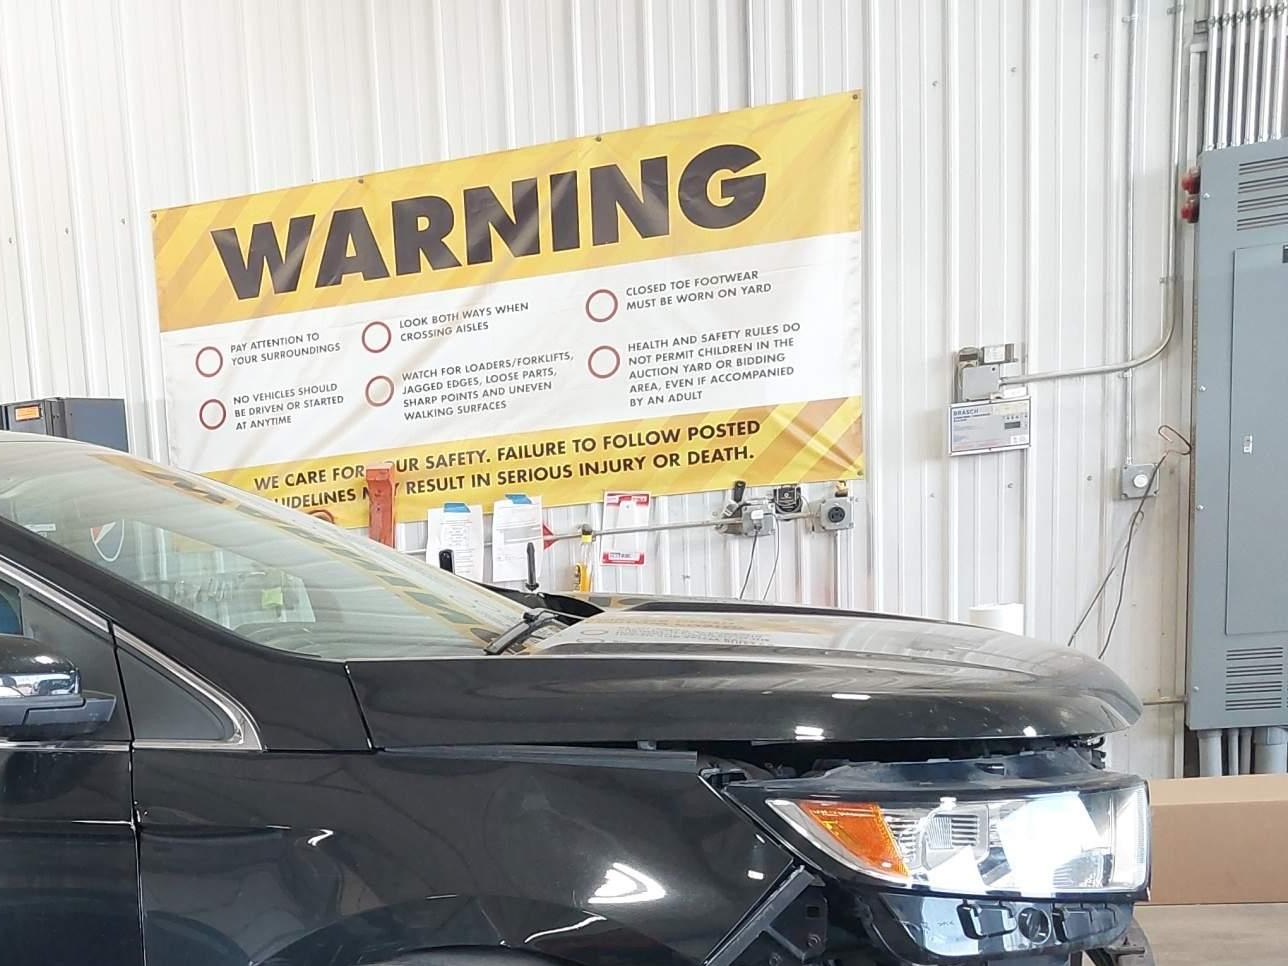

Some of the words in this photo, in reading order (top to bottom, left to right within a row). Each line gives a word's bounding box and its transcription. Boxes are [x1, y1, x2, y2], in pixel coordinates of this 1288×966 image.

[211, 143, 767, 300] WARNING
[626, 283, 666, 296] CLOSED
[670, 280, 691, 289] TOE
[694, 271, 758, 287] FOOTWEAR
[626, 299, 656, 310] MUST
[660, 297, 672, 306] BE
[676, 291, 713, 304] WORN
[718, 288, 737, 297] ON
[741, 283, 772, 295] YARD
[400, 317, 428, 328] LOOK
[432, 312, 459, 324] BOTH
[462, 307, 492, 319] WAYS
[495, 302, 529, 314] WHEN
[231, 343, 247, 352] PAY
[251, 335, 303, 350] ATTENTION
[306, 333, 319, 341] TO
[401, 327, 452, 342] CROSSING
[456, 322, 489, 333] AISLES
[628, 339, 668, 352] HEALTH
[672, 335, 697, 346] AND
[701, 330, 741, 343] SAFETY
[745, 325, 779, 338] RULES
[783, 323, 800, 332] DO
[232, 355, 257, 366] YOUR
[261, 343, 340, 361] SURROUNDINGS
[629, 355, 652, 366] NOT
[656, 350, 693, 362] PERMIT
[698, 343, 752, 357] CHILDREN
[757, 341, 769, 350] IN
[774, 338, 794, 347] THE
[402, 369, 437, 381] WATCH
[441, 366, 461, 376] FOR
[465, 352, 574, 373] LOADERS/FORKLIFTS,
[629, 366, 678, 379] AUCTION
[682, 362, 711, 373] YARD
[716, 359, 732, 368] OR
[736, 353, 785, 366] BIDDING
[402, 382, 443, 395] JAGGED
[447, 377, 482, 389] EDGES,
[486, 372, 519, 383] LOOSE
[522, 367, 557, 379] PARTS,
[630, 382, 661, 393] AREA,
[666, 378, 693, 389] EVEN
[698, 377, 706, 385] IF
[711, 366, 794, 384] ACCOMPANIED
[234, 396, 249, 405] NO
[253, 389, 295, 401] VEHICLES
[299, 383, 337, 395] SHOULD
[235, 409, 246, 417] BE
[249, 404, 283, 415] DRIVEN
[287, 401, 300, 410] OR
[304, 396, 344, 407] STARTED
[403, 396, 437, 407] SHARP
[441, 391, 478, 403] POINTS
[482, 388, 505, 397] AND
[509, 382, 552, 394] UNEVEN
[630, 398, 643, 407] BY
[648, 395, 663, 405] AN
[668, 391, 702, 402] ADULT
[236, 422, 247, 430] AT
[250, 416, 291, 428] ANYTIME
[404, 407, 453, 421] WALKING
[457, 401, 506, 414] SURFACES
[254, 473, 279, 490] WE
[285, 469, 326, 487] CARE
[333, 465, 364, 481] FOR
[384, 454, 419, 474] UR
[426, 449, 490, 469] SAFETY.
[497, 441, 566, 461] FAILURE
[572, 438, 596, 453] TO
[603, 429, 681, 449] FOLLOW
[688, 420, 760, 440] POSTED
[274, 488, 356, 509] UIDELINES
[406, 476, 464, 494] RESULT
[471, 473, 490, 488] IN
[497, 465, 573, 485] SERIOUS
[579, 456, 645, 476] INJURY
[653, 452, 681, 468] OR
[688, 446, 754, 465] DEATH.
